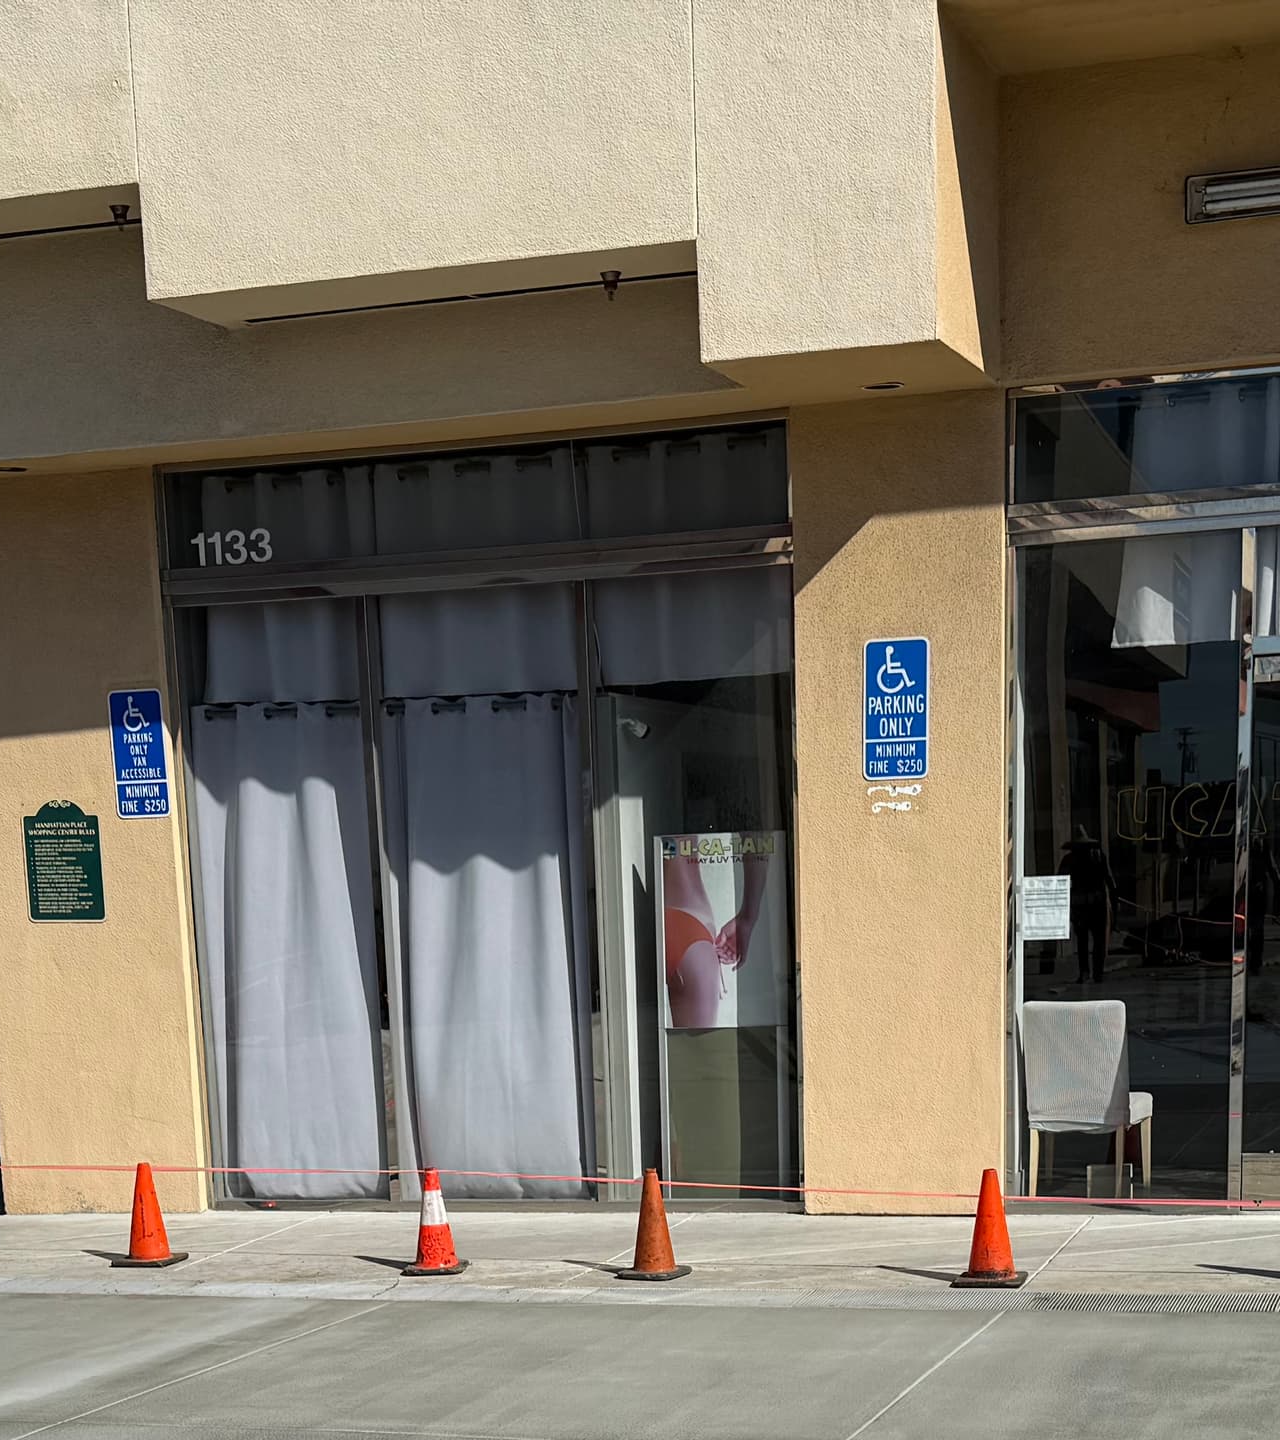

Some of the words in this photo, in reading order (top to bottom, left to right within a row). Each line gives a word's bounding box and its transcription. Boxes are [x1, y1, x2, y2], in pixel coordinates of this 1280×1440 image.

[190, 528, 272, 566] 1133
[868, 694, 924, 715] PARKING
[880, 717, 913, 737] ONLY
[124, 732, 153, 743] PARKING
[130, 745, 148, 755] ONLY
[876, 744, 916, 758] MINIMUM
[133, 757, 147, 767] VAN
[869, 760, 888, 774] FINE
[897, 759, 922, 773] $250
[121, 768, 161, 779] ACCESSIBLE
[126, 784, 159, 798] MINIMUM
[122, 800, 138, 813] FINE
[145, 800, 166, 813] $250
[680, 837, 774, 856] U-CA-TAN
